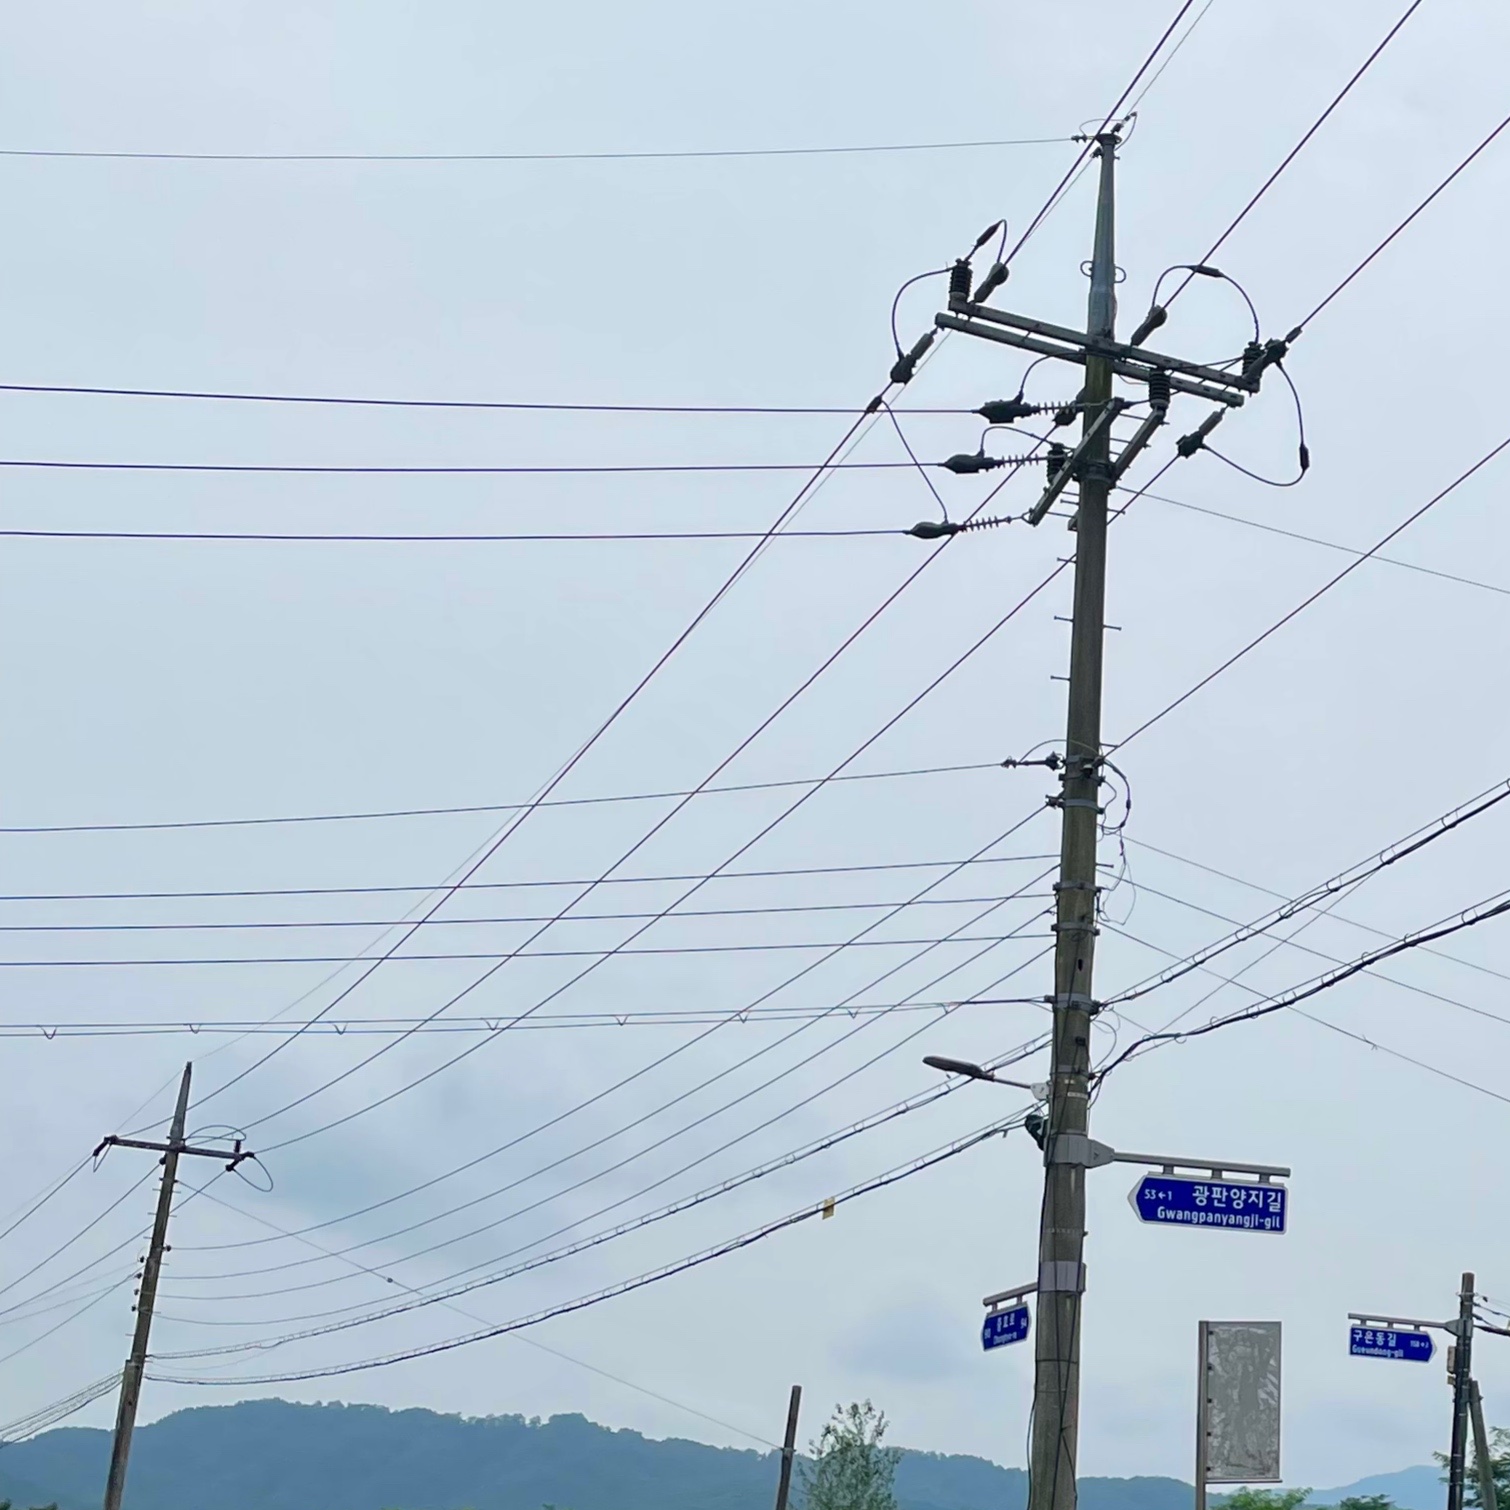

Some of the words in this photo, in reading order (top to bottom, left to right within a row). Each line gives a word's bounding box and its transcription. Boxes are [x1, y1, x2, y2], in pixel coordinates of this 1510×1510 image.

[1144, 1188, 1157, 1200] 53
[1192, 1185, 1281, 1213] 광판양지길
[1157, 1205, 1281, 1230] Gwangpanyangji-gil
